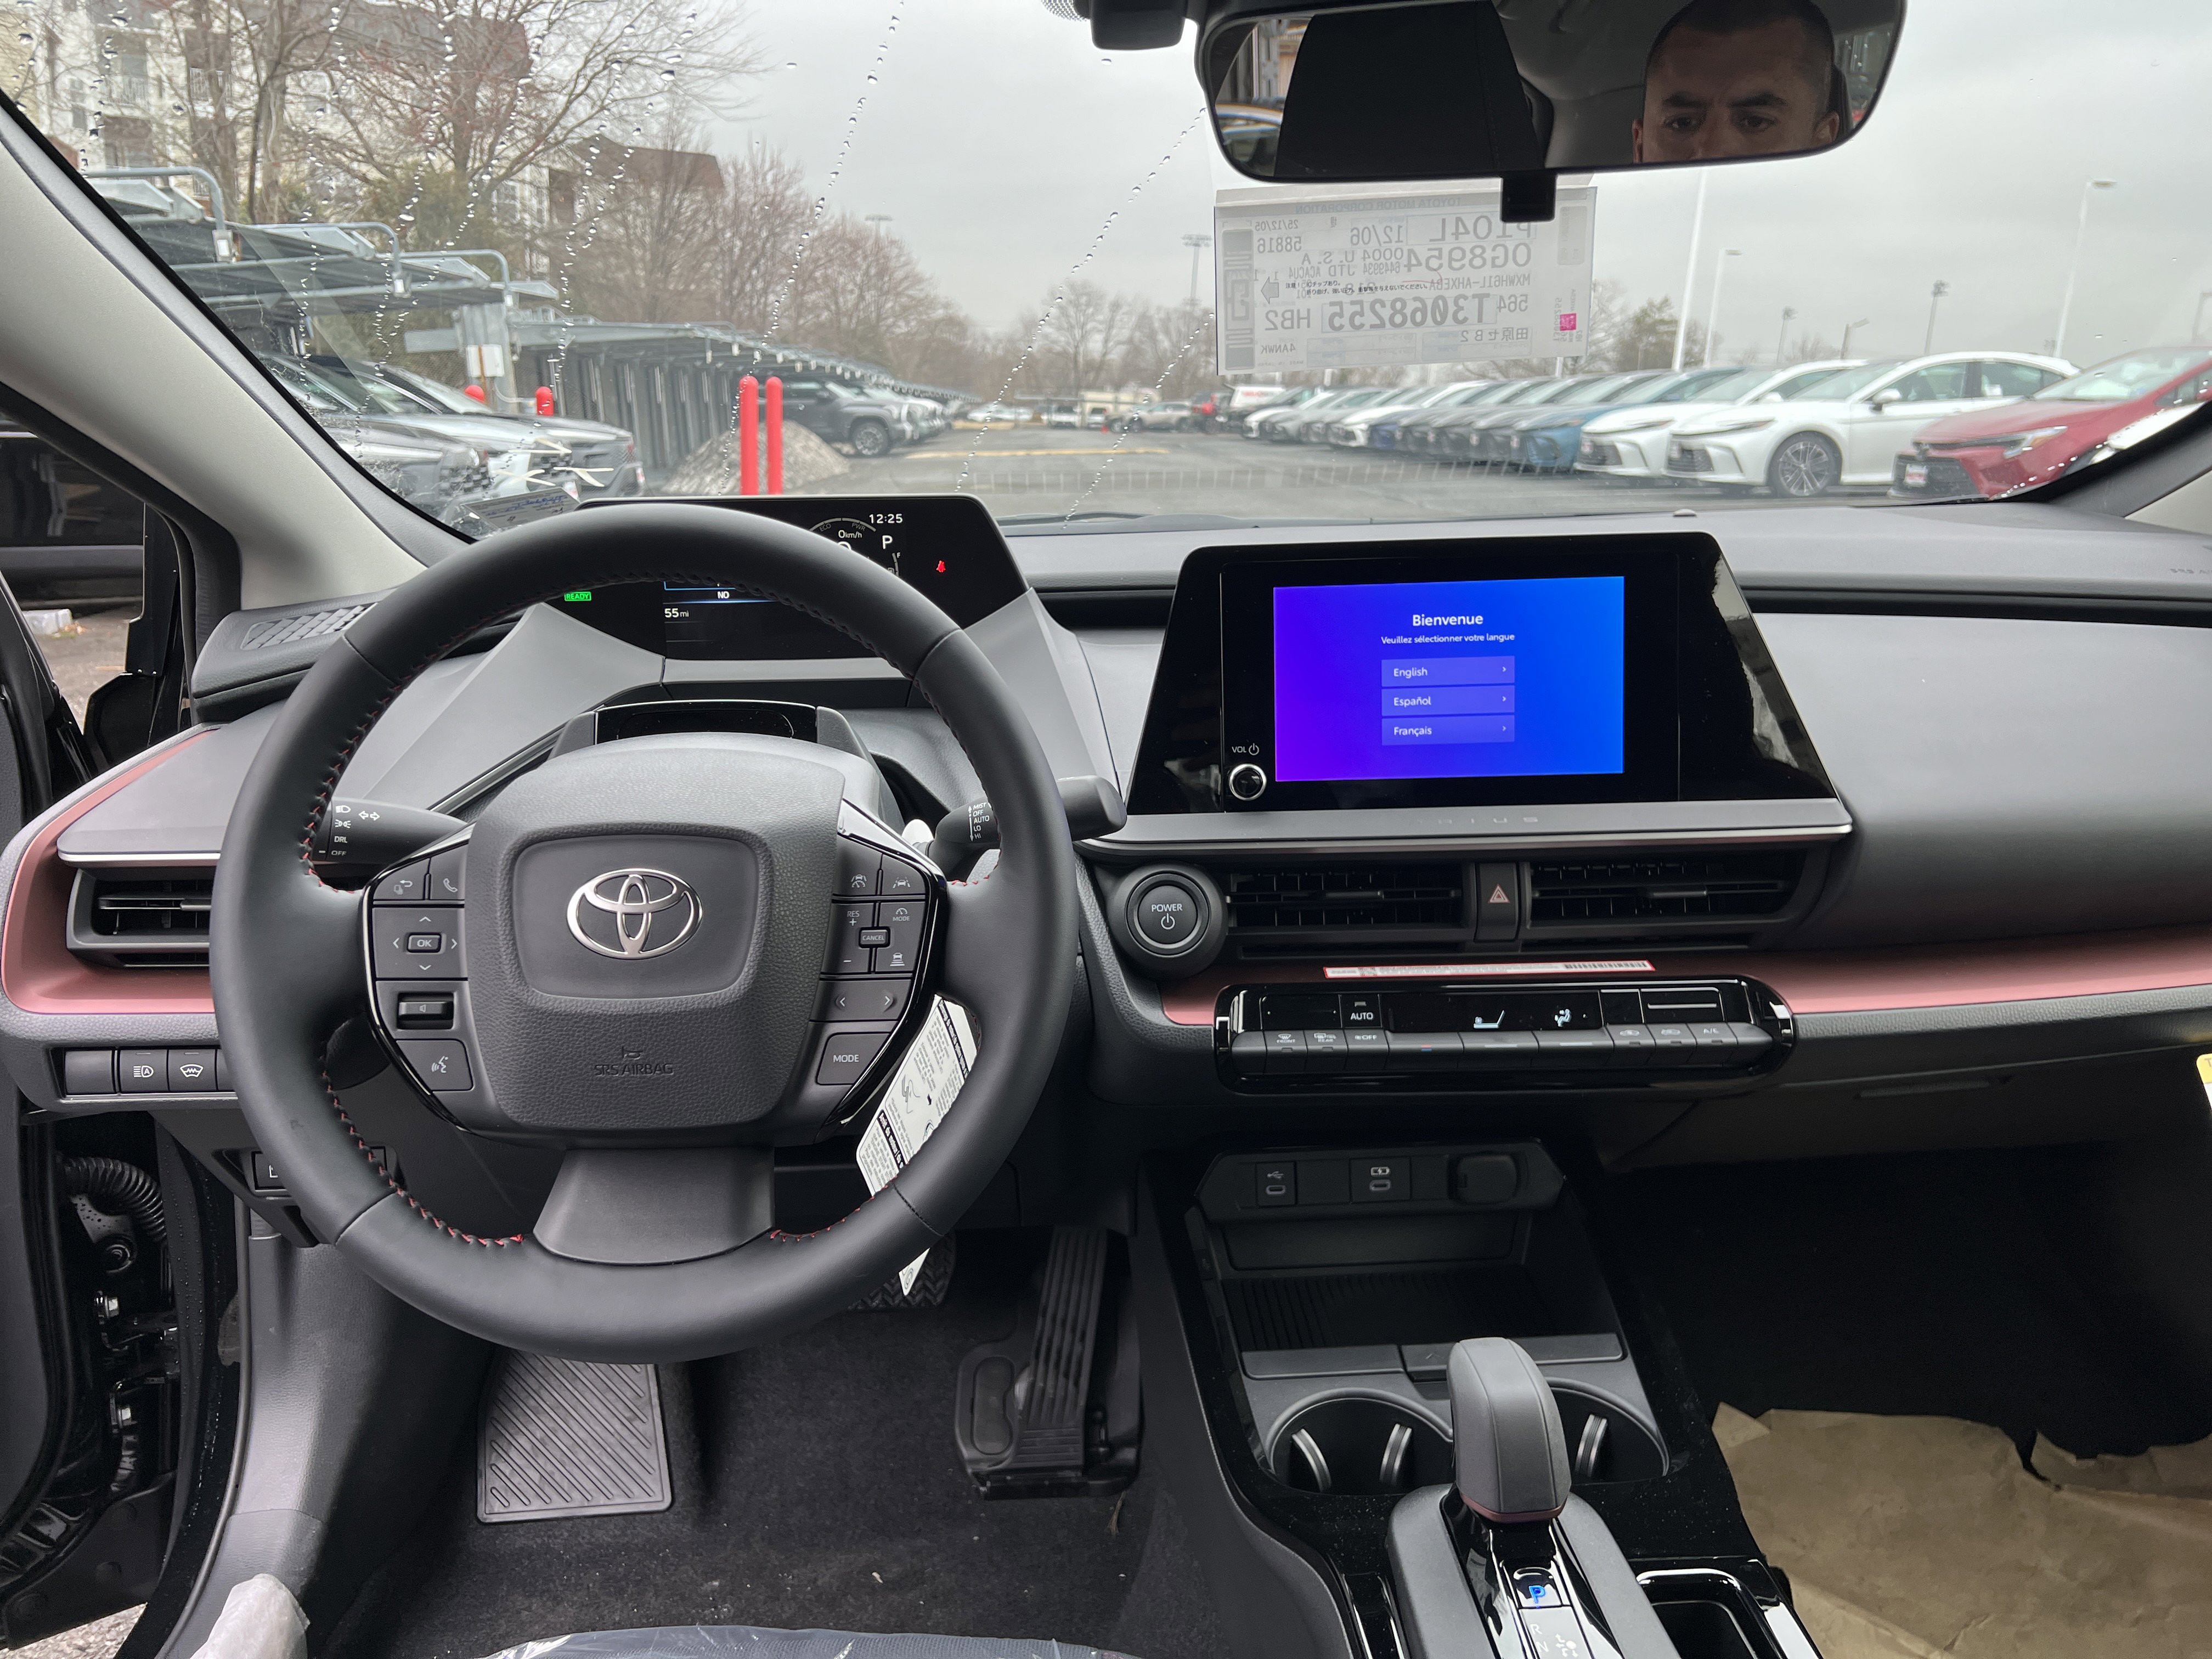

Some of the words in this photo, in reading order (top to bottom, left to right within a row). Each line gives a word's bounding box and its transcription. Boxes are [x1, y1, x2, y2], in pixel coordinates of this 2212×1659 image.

[869, 514, 903, 524] 12:25
[819, 523, 832, 532] ECO
[851, 522, 866, 532] PWR
[882, 535, 893, 550] P
[1413, 614, 1483, 627] Bienvenue
[1381, 636, 1412, 644] Veuillez
[1414, 635, 1463, 644] sélectionner
[1486, 633, 1515, 642] langue
[1393, 667, 1427, 679] English
[1393, 696, 1431, 707] Español
[1394, 726, 1432, 737] Français
[1231, 746, 1247, 754] VOL
[973, 815, 990, 824] AUTO
[334, 836, 348, 844] DRL
[1151, 904, 1183, 912] POWER
[417, 939, 432, 947] OK
[1350, 1012, 1374, 1020] AUTO
[833, 1053, 859, 1063] MODE
[593, 1064, 619, 1076] SRS
[621, 1063, 674, 1076] AIRBAG
[1528, 1585, 1545, 1604] P
[1531, 1623, 1542, 1635] R
[1536, 1641, 1549, 1653] N
